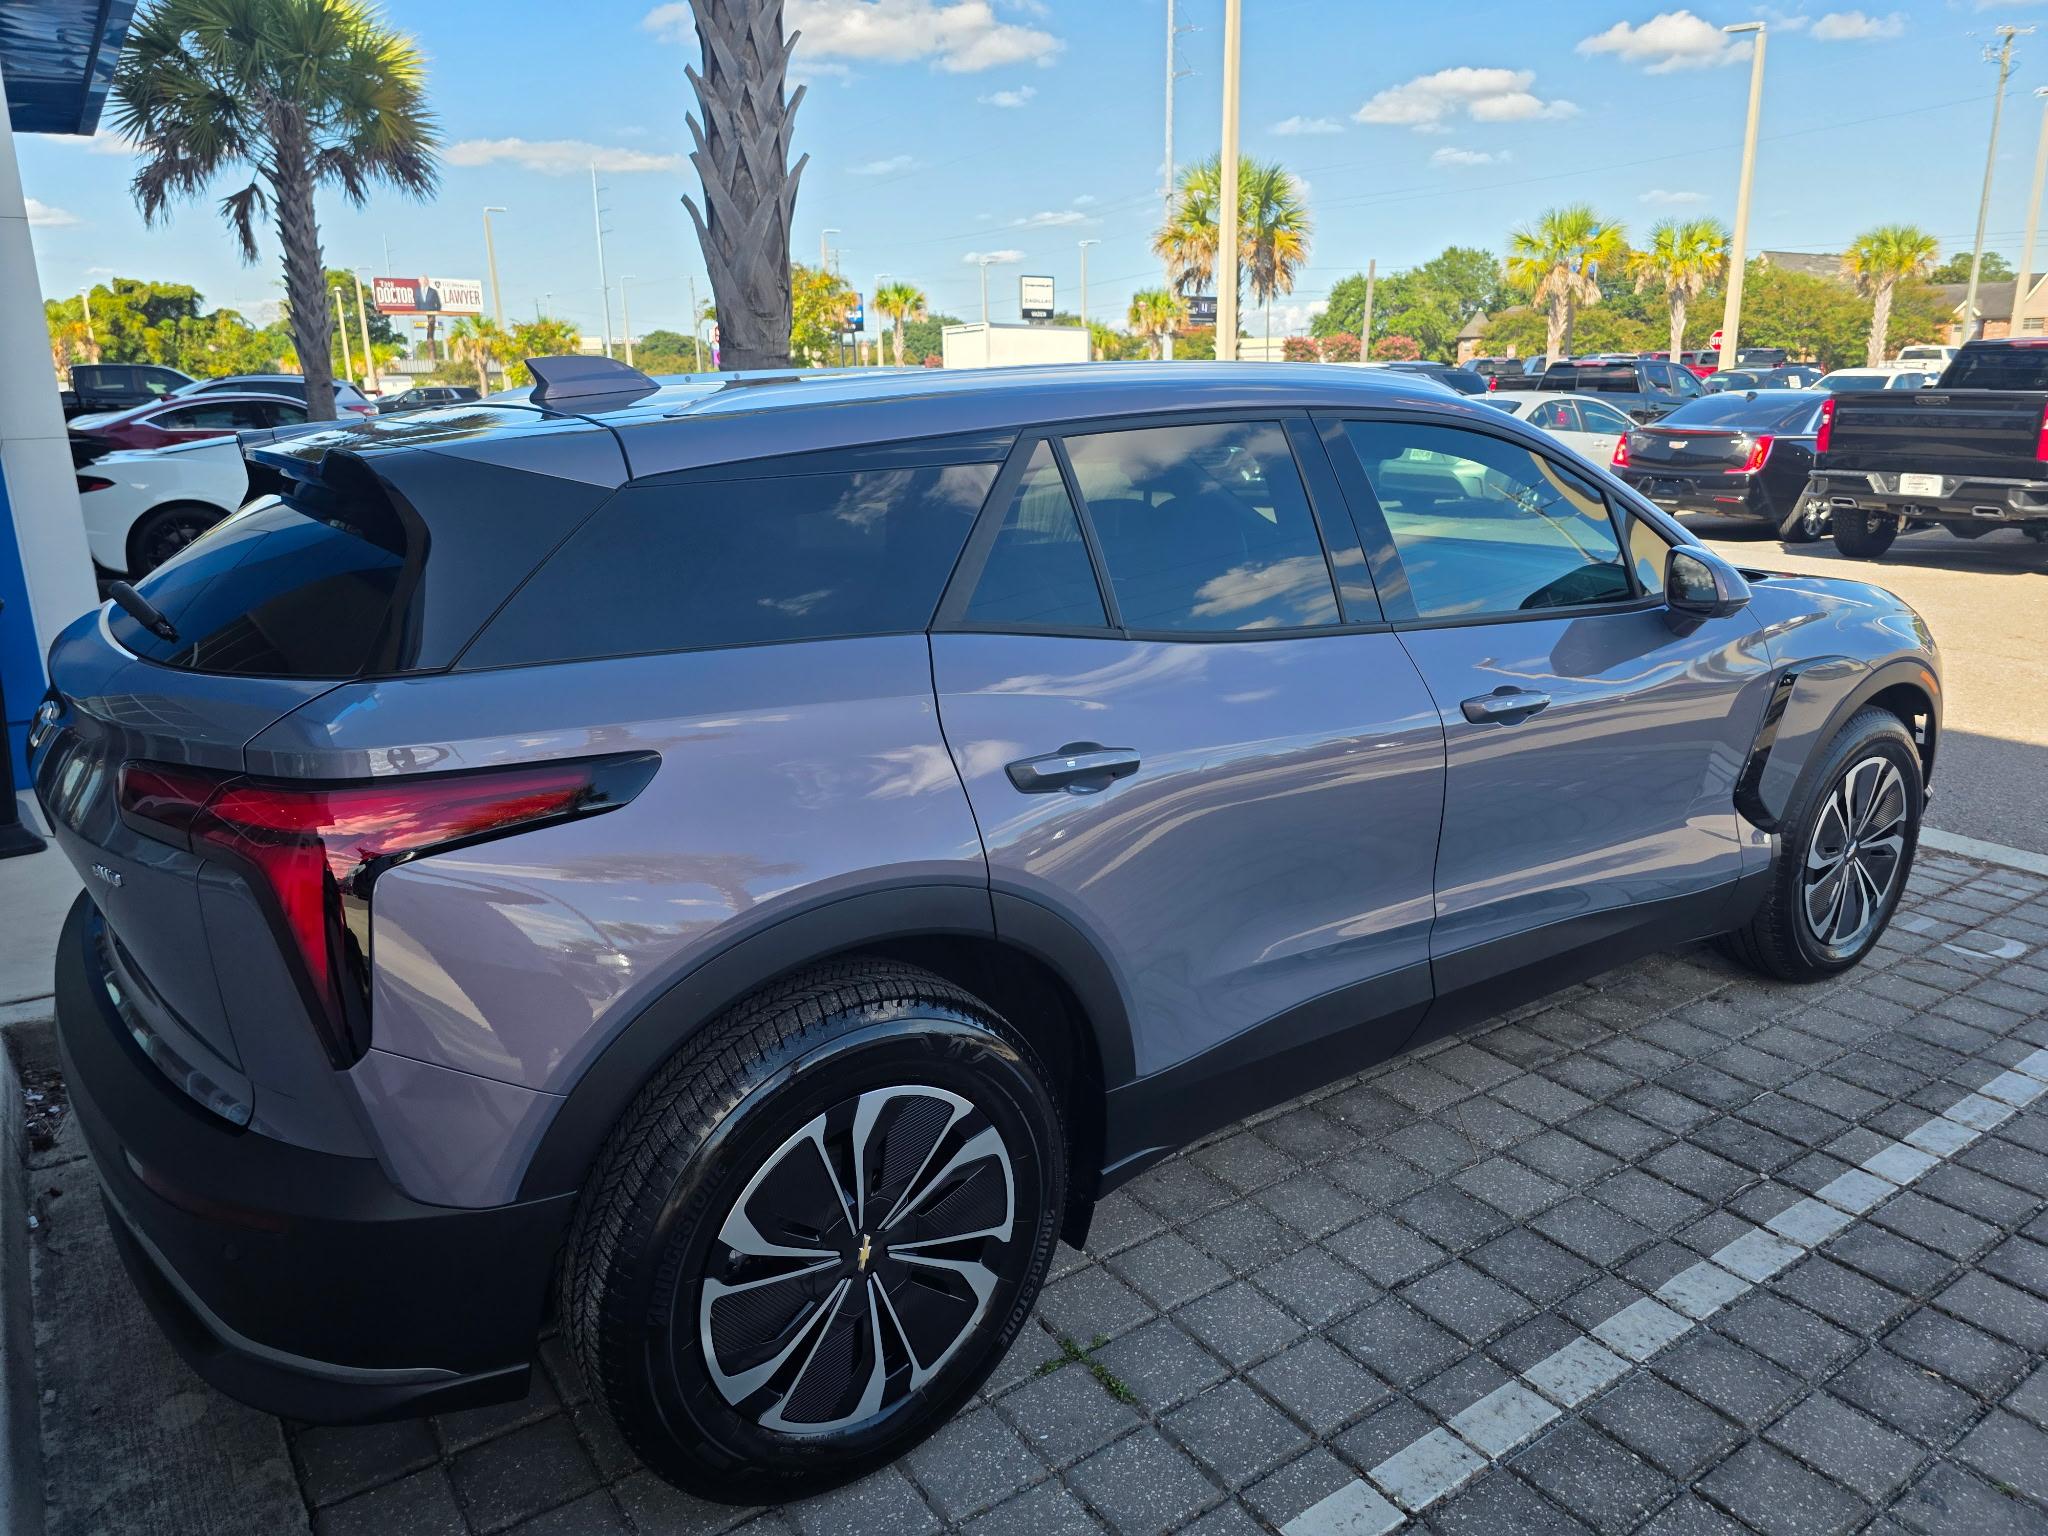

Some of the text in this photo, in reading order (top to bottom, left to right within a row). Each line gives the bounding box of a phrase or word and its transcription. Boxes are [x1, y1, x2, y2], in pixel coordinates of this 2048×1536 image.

[376, 287, 415, 304] DOCTOR
[443, 288, 481, 305] LAWYER
[1711, 336, 1723, 346] STO
[998, 1207, 1057, 1347] BRIDGESTONE
